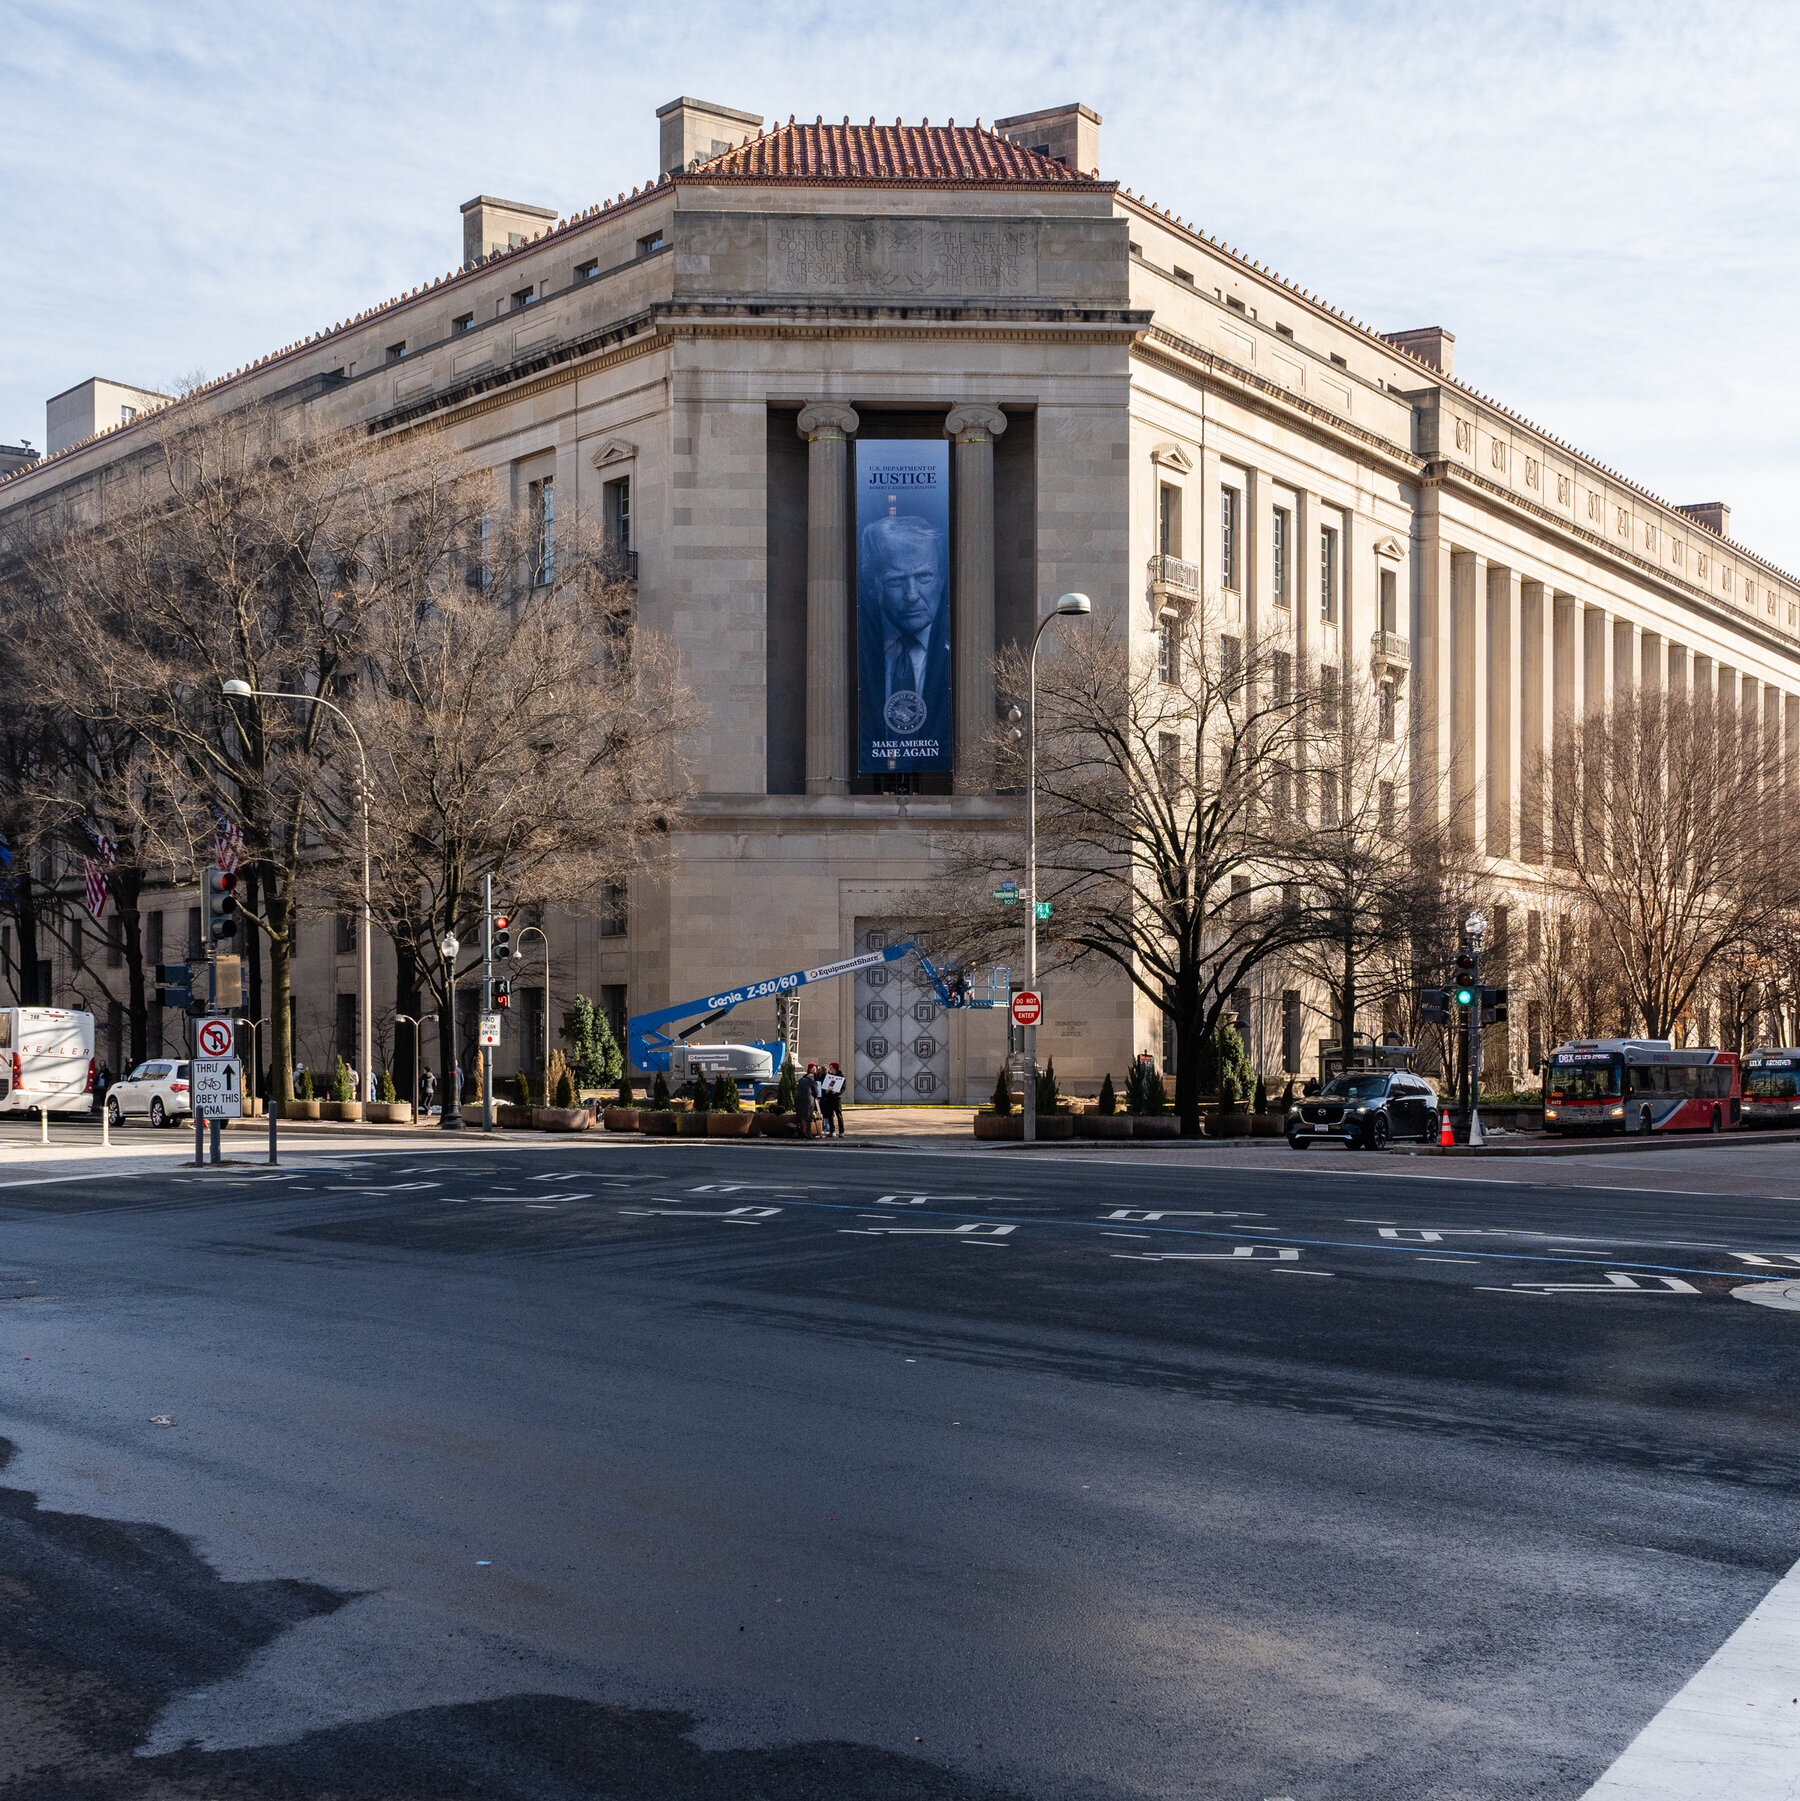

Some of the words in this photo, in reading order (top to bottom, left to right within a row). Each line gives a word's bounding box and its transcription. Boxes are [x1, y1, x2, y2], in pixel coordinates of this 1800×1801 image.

[777, 229, 839, 241] JUSTICE
[845, 230, 861, 241] IN
[942, 232, 965, 243] THE
[973, 232, 996, 244] LIFE
[1001, 232, 1028, 244] AND
[777, 240, 840, 252] CONDUCT
[844, 241, 862, 253] OF
[944, 242, 967, 254] THE
[973, 243, 1009, 255] STATE
[1015, 243, 1026, 255] IS
[787, 251, 863, 263] POSSIBLE
[938, 253, 969, 265] ONLY
[972, 254, 987, 265] AS
[990, 254, 1019, 266] FIRST
[800, 262, 848, 274] RESIDES
[852, 263, 864, 275] IN
[944, 264, 967, 276] THE
[973, 265, 1019, 277] HEARTS
[785, 272, 808, 284] AND
[812, 273, 849, 285] SOULS
[940, 275, 961, 287] THE
[869, 472, 937, 485] JUSTICE
[872, 740, 898, 748] MAKE
[899, 739, 939, 747] AMERICA
[871, 748, 901, 758] SAFE
[902, 747, 940, 757] AGAIN
[818, 953, 879, 976] EquipmentShare
[707, 991, 743, 1009] Genie
[747, 974, 798, 999] Z-80/60
[22, 1045, 90, 1056] KELLER
[195, 1063, 218, 1073] THRU
[195, 1094, 218, 1104] OBEY
[221, 1093, 239, 1103] THIS
[198, 1105, 226, 1115] GNAL
